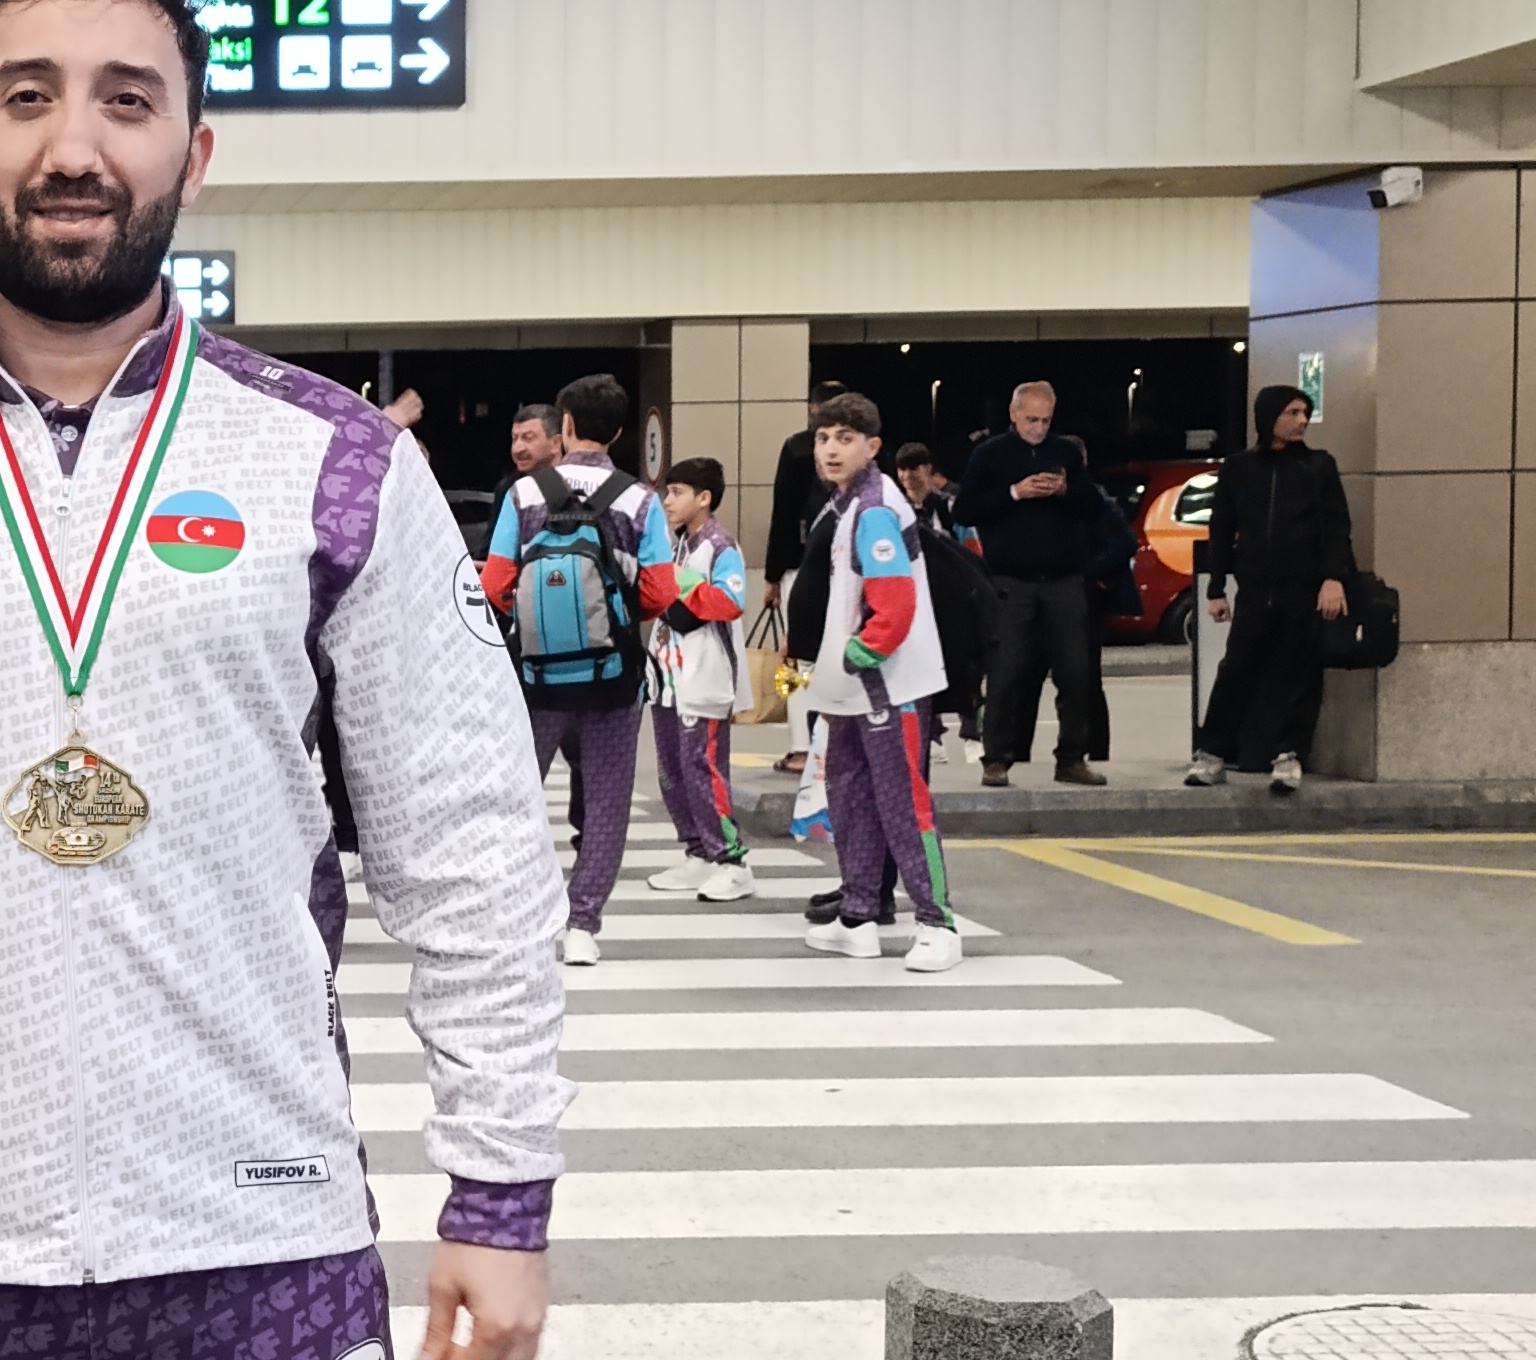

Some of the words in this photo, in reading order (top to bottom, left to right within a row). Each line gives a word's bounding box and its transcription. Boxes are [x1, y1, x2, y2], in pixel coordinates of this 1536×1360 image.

[259, 365, 284, 380] 10
[224, 405, 277, 415] BLACK
[221, 419, 260, 428] BELT
[257, 440, 306, 450] BLACK
[649, 432, 656, 463] 5
[251, 452, 288, 462] BELT
[240, 468, 291, 477] BLACK
[254, 556, 296, 569] BELT
[188, 578, 228, 595] BELT
[240, 573, 289, 586] BLACK
[462, 582, 483, 592] BLAC
[239, 593, 274, 607] BELT
[177, 598, 231, 619] BLACK
[111, 630, 164, 656] BLACK
[162, 637, 214, 661] BLACK
[206, 649, 258, 665] BLACK
[150, 680, 204, 704] BLACK
[73, 804, 113, 815] SHOTOKAN
[115, 804, 145, 816] KARATE
[193, 855, 243, 877] BLACK
[148, 874, 184, 895] BELT
[234, 882, 269, 900] BELT
[221, 897, 270, 920] BLACK
[245, 944, 293, 966] BLACK
[165, 979, 213, 1001] BLACK
[324, 969, 333, 998] BELT
[161, 1002, 200, 1016] BELT
[327, 1002, 335, 1037] BLACK
[245, 1165, 305, 1179] YUSIFOV
[309, 1165, 321, 1176] R.
